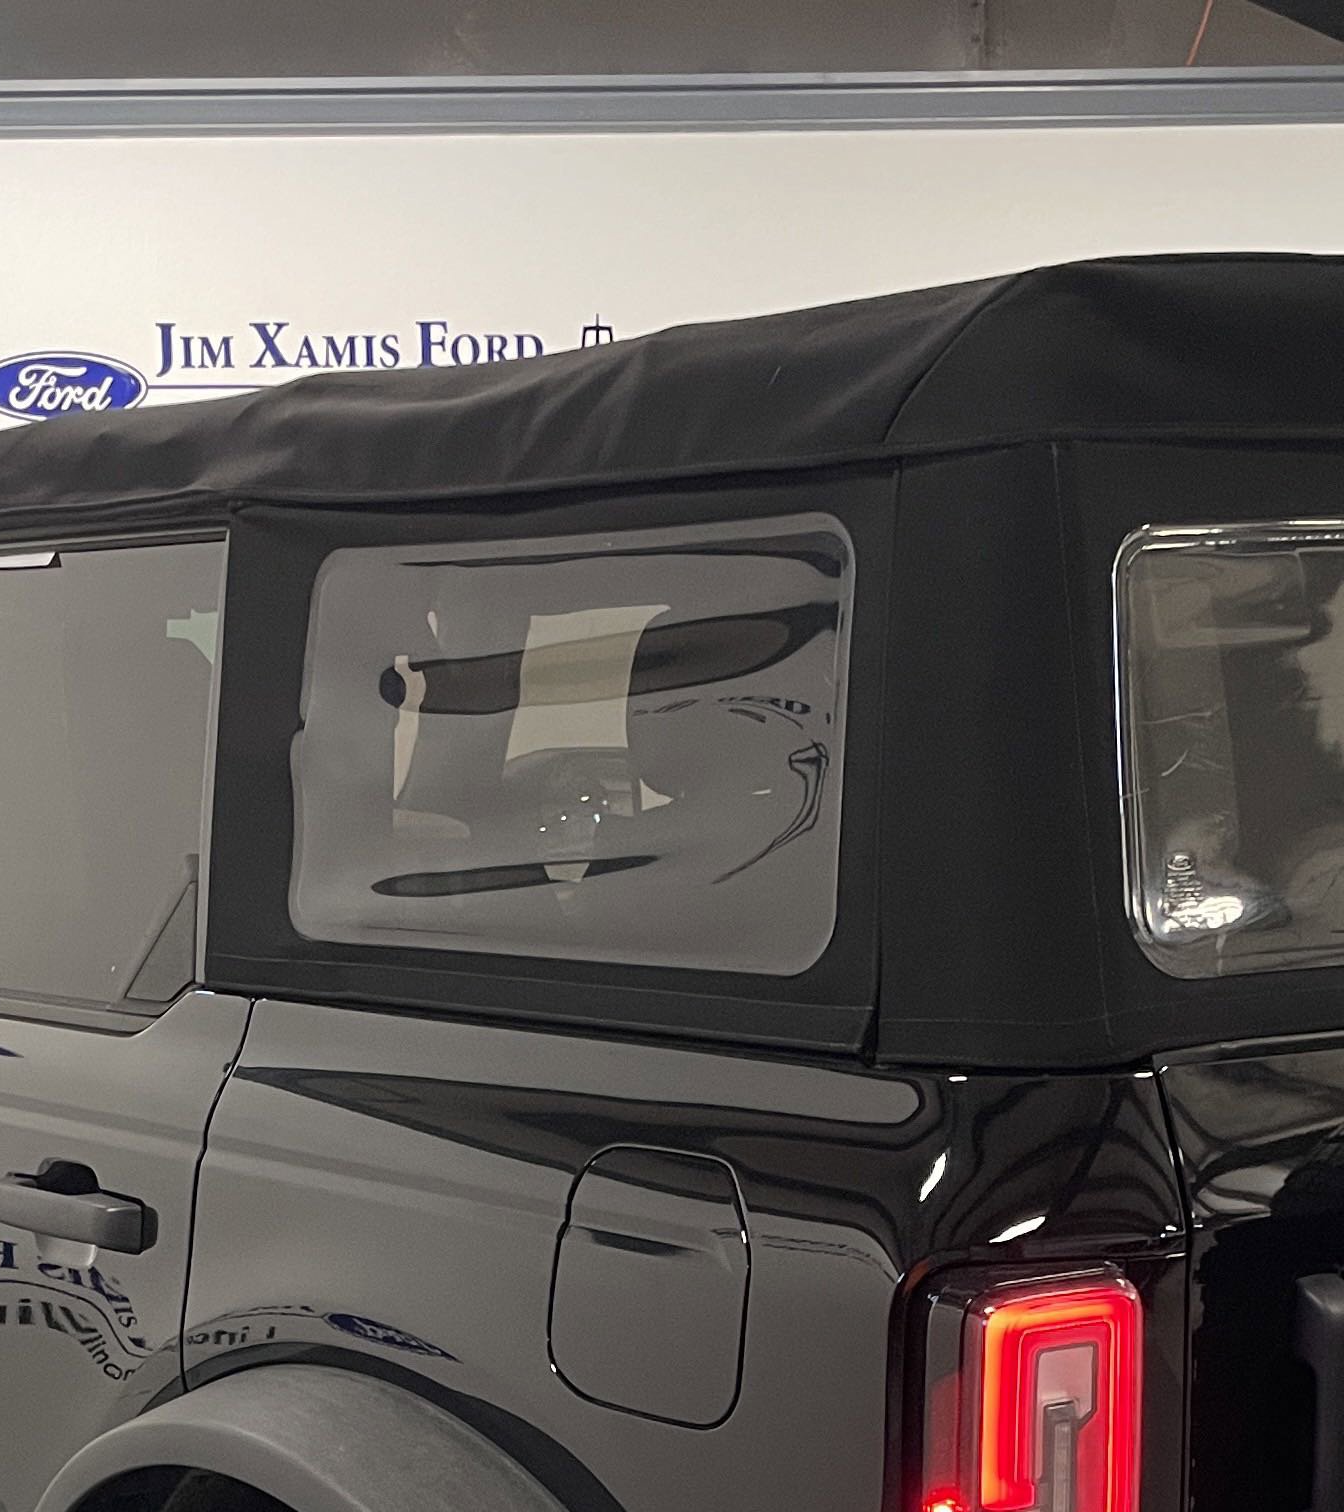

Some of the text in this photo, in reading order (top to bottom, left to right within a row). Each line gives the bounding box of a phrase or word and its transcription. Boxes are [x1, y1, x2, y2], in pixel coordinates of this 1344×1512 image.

[154, 321, 543, 377] JIM XAMIS FORD
[9, 366, 113, 411] Ford
